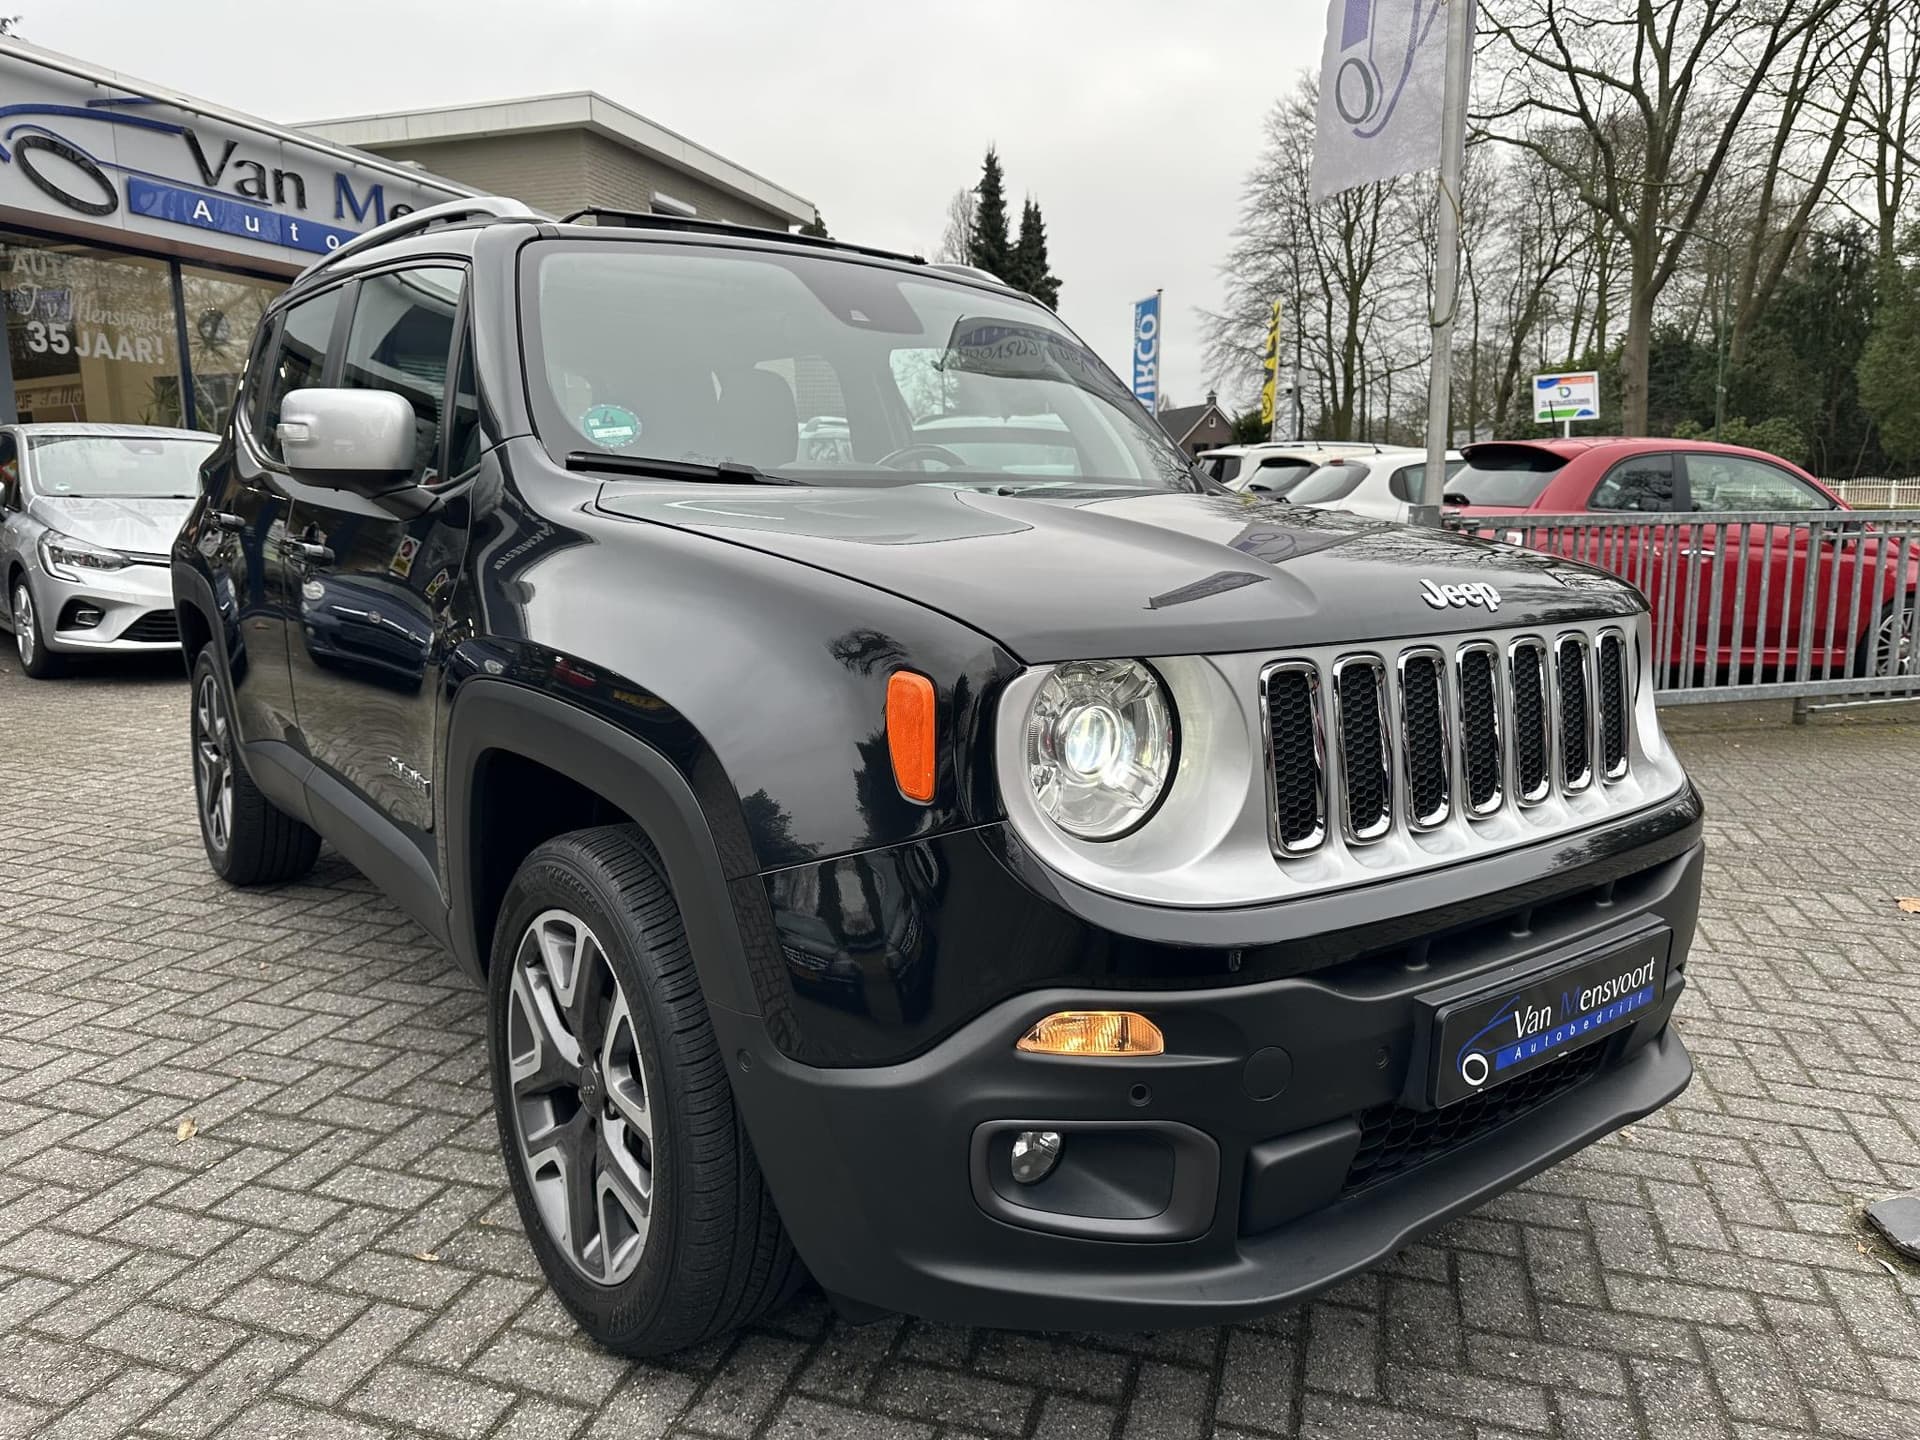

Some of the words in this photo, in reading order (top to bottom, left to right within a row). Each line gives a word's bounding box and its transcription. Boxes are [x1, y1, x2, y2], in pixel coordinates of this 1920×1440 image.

[182, 127, 307, 210] Van
[192, 199, 340, 251] Auto
[27, 320, 71, 354] 35
[74, 331, 165, 364] JAAR!
[1419, 578, 1501, 613] Jeep
[1514, 1005, 1552, 1038] Van
[1560, 956, 1655, 1020] Mensvoort
[1514, 991, 1643, 1060] Autobedrijf
